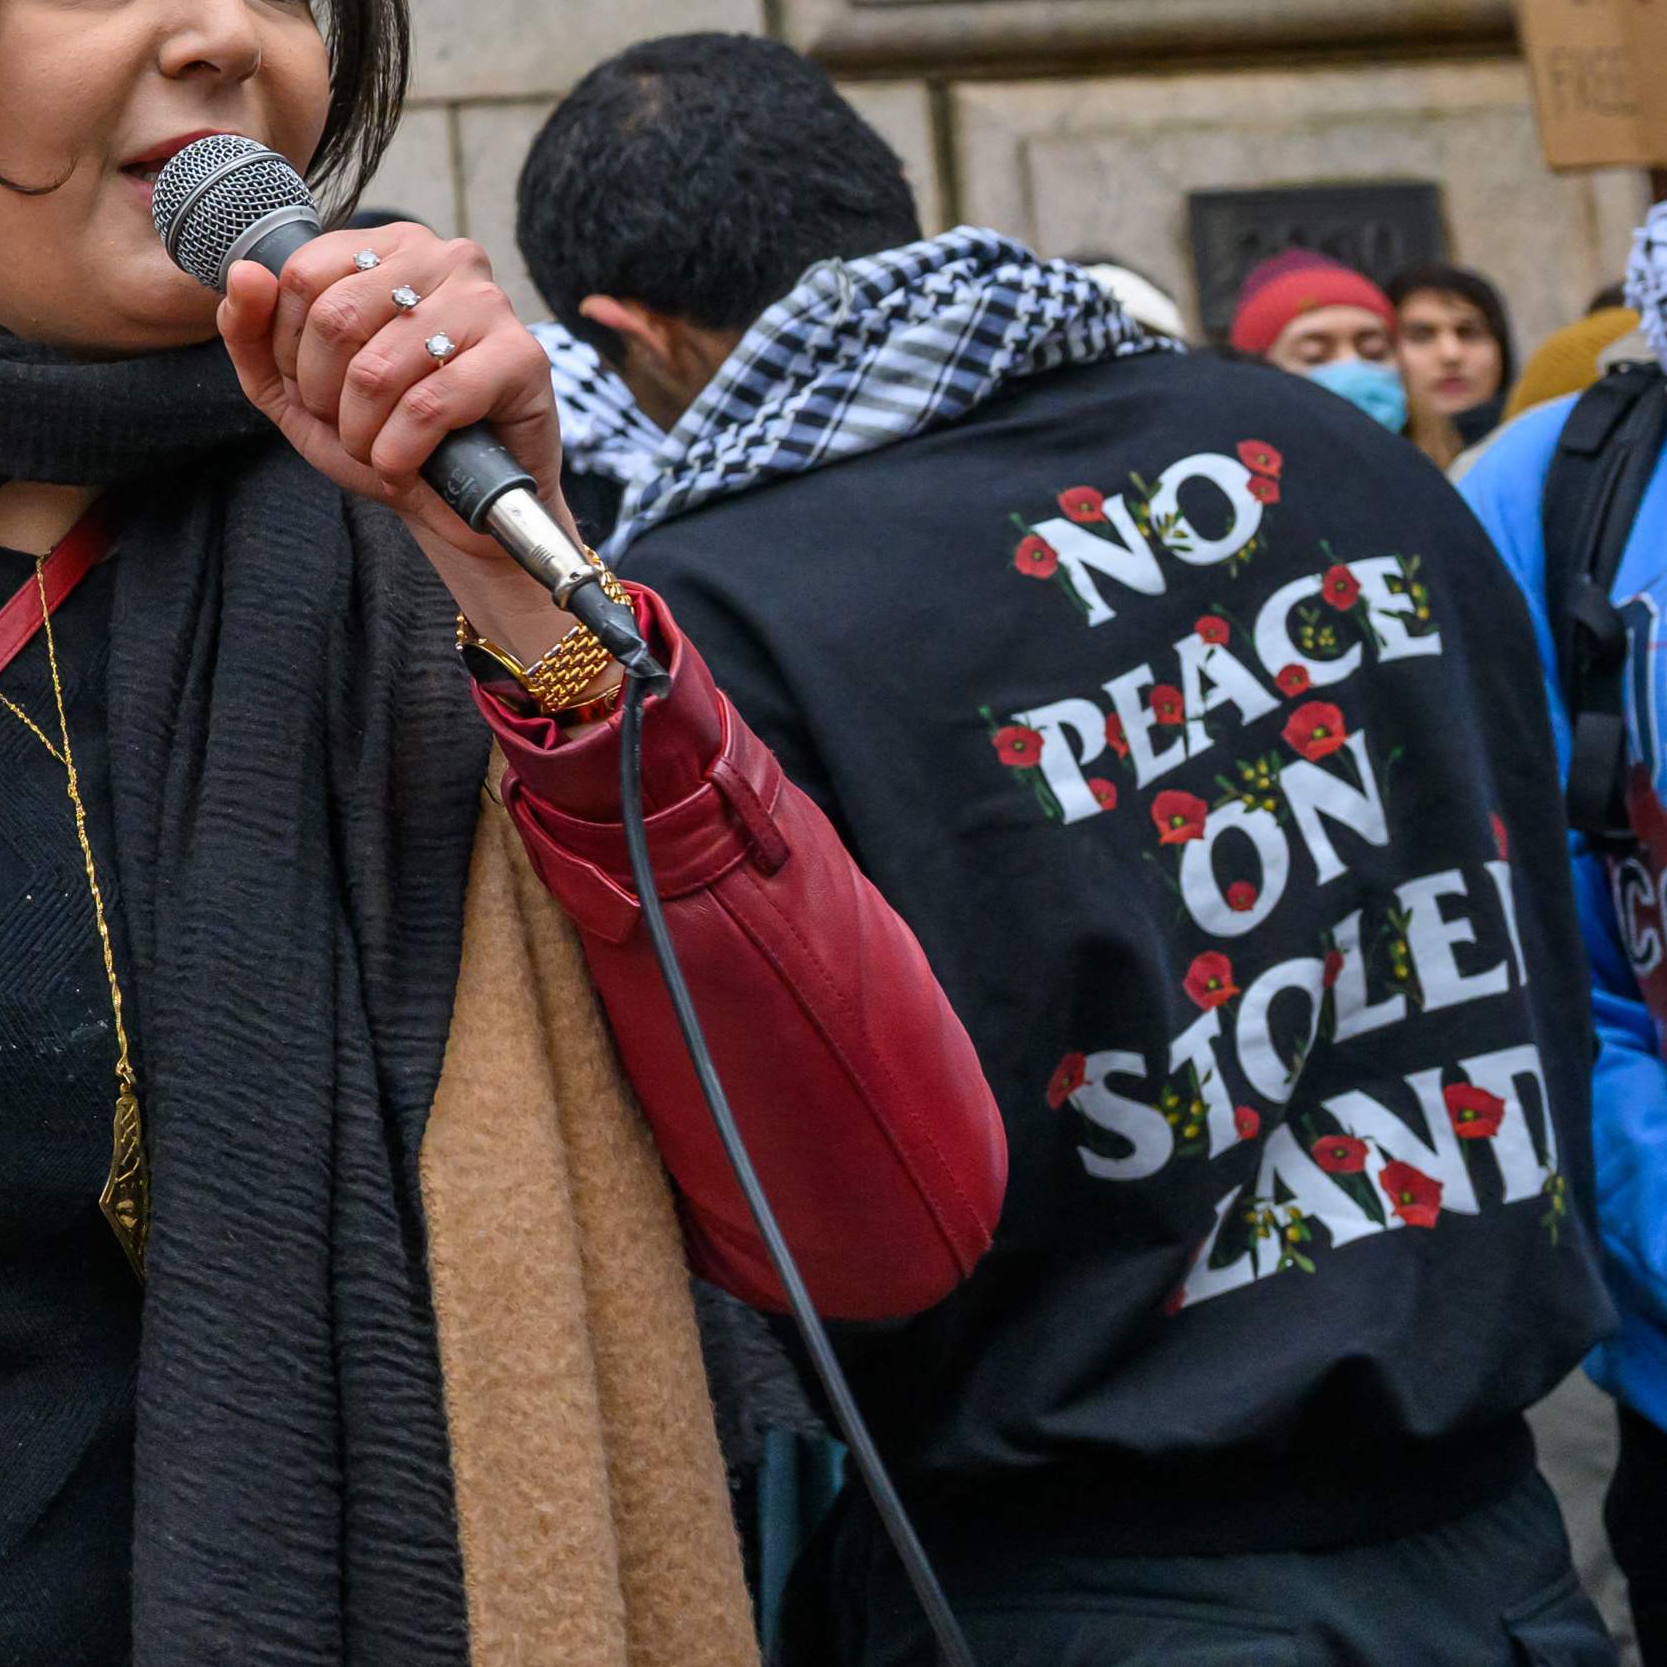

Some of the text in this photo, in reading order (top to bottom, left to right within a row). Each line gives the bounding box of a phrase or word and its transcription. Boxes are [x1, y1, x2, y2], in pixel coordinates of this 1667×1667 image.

[1032, 453, 1264, 627] NO
[1011, 555, 1443, 826] PEACE
[1180, 729, 1390, 937] ON
